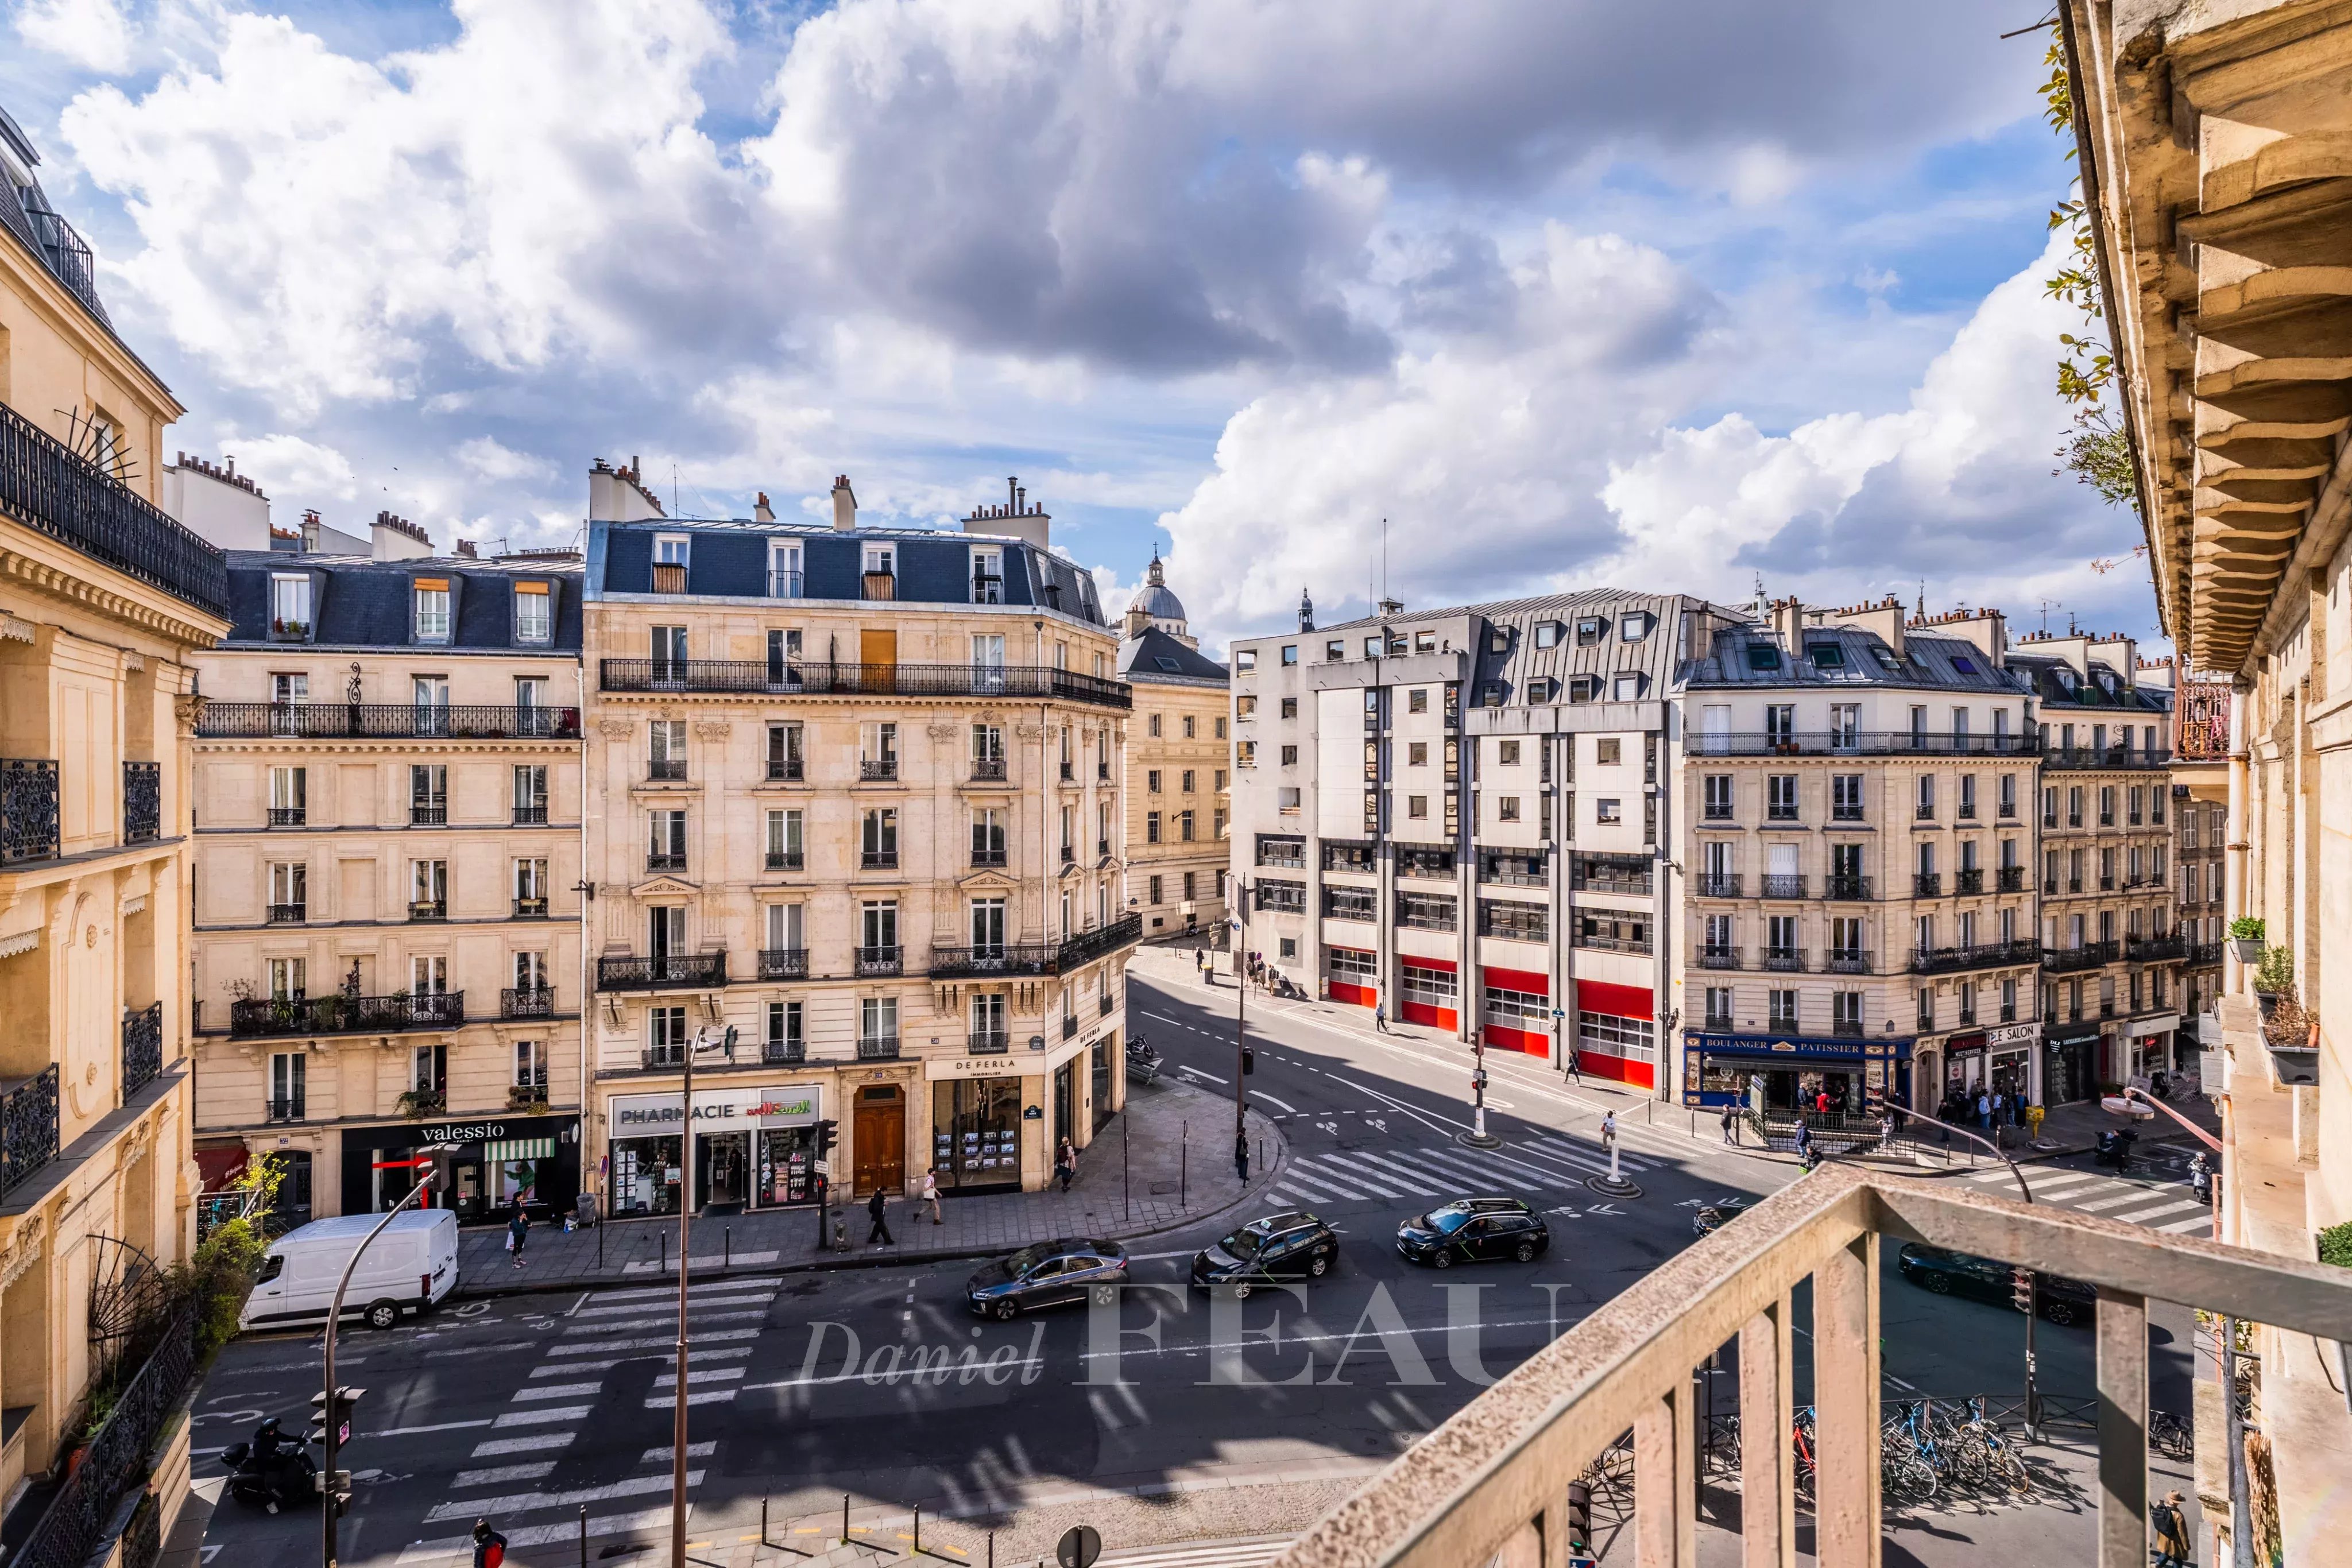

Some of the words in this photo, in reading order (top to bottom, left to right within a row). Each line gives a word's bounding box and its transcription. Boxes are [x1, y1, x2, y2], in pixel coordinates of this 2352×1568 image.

[1080, 1035, 1086, 1043] DE
[1087, 1027, 1100, 1039] FERLA
[2007, 1025, 2033, 1040] SALON
[1706, 1039, 1767, 1048] BOULANGER
[1800, 1043, 1859, 1053] PATISSIER
[977, 1060, 1015, 1068] FERLA
[621, 1104, 735, 1124] PHARMACIE
[421, 1122, 504, 1141] valessio
